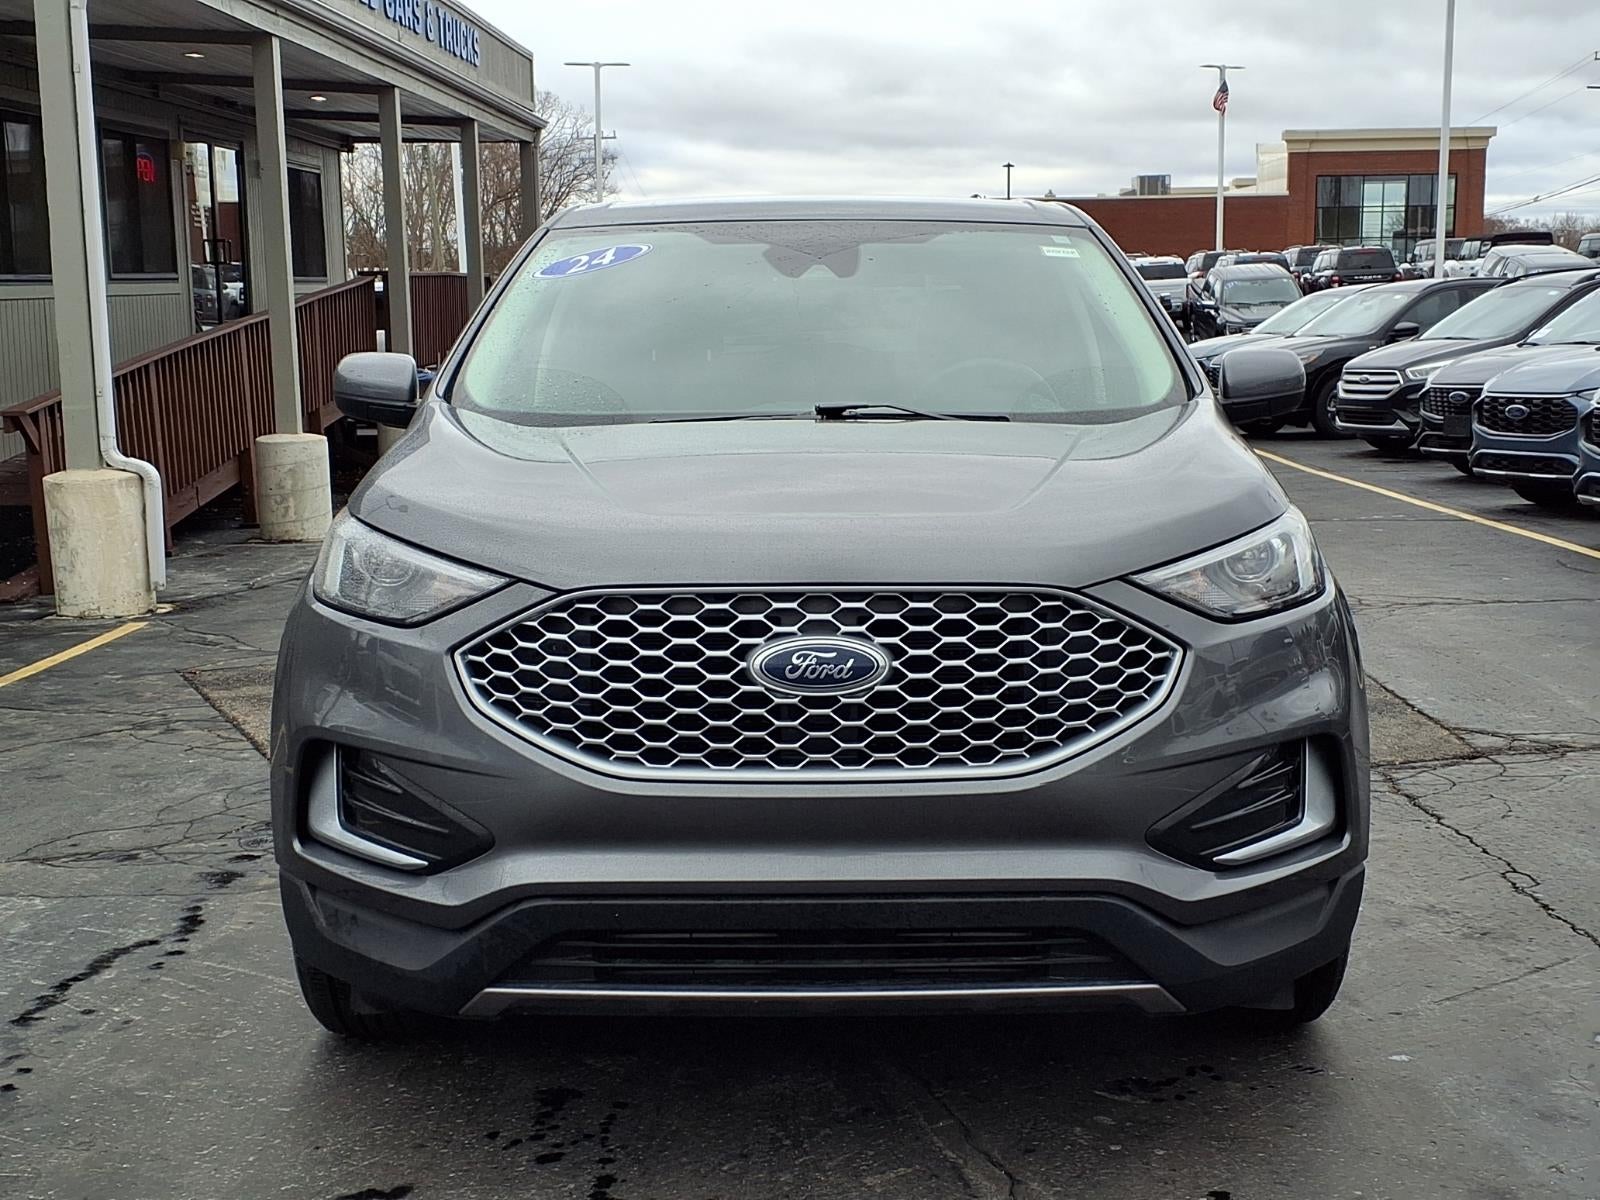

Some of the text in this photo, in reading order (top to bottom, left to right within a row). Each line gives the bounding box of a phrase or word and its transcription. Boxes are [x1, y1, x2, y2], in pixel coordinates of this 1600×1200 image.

[425, 1, 435, 42] &
[436, 7, 480, 68] TRUCKS
[566, 247, 617, 275] 24
[784, 650, 854, 680] Ford
